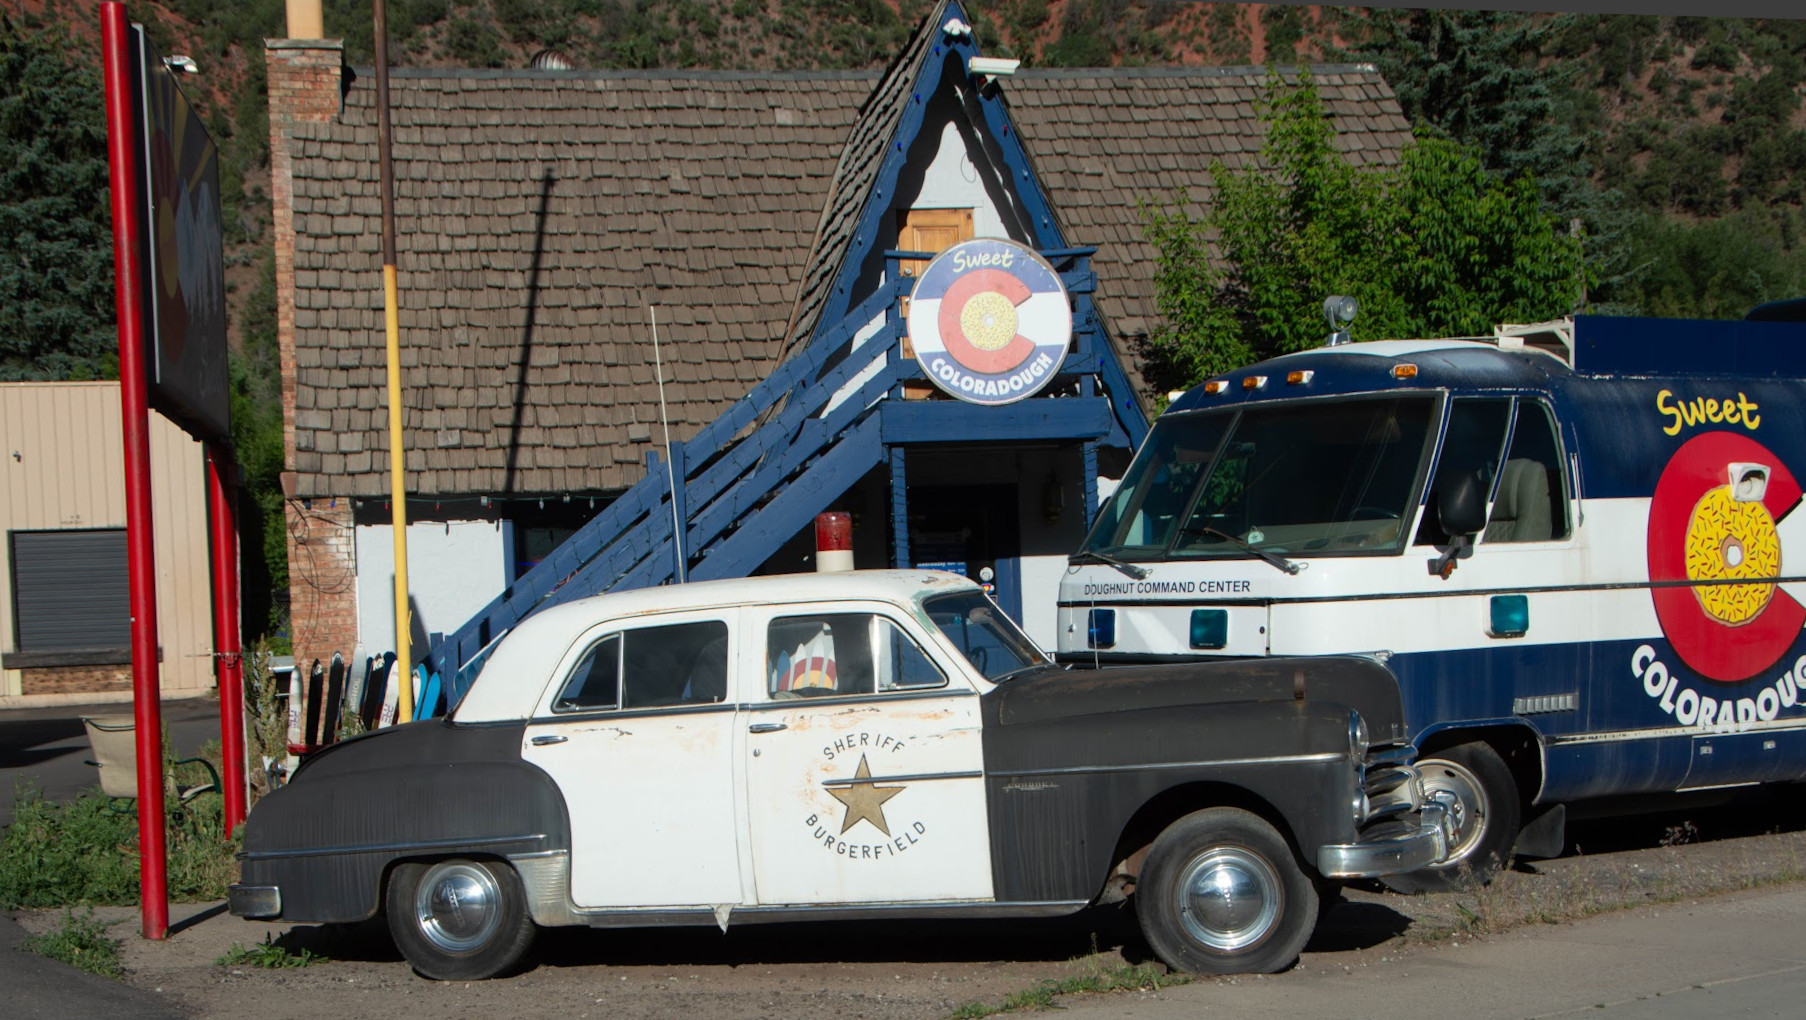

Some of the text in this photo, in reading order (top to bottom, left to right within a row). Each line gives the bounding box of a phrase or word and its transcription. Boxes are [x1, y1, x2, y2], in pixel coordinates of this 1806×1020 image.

[952, 249, 1015, 273] Sweet
[931, 352, 1053, 396] COLORADOUGH
[1656, 389, 1761, 436] Sweet
[1085, 580, 1251, 595] DOUGHNUT COMMAND CENTER
[823, 732, 906, 760] SHERIFF
[805, 813, 926, 860] BURGERFIELD
